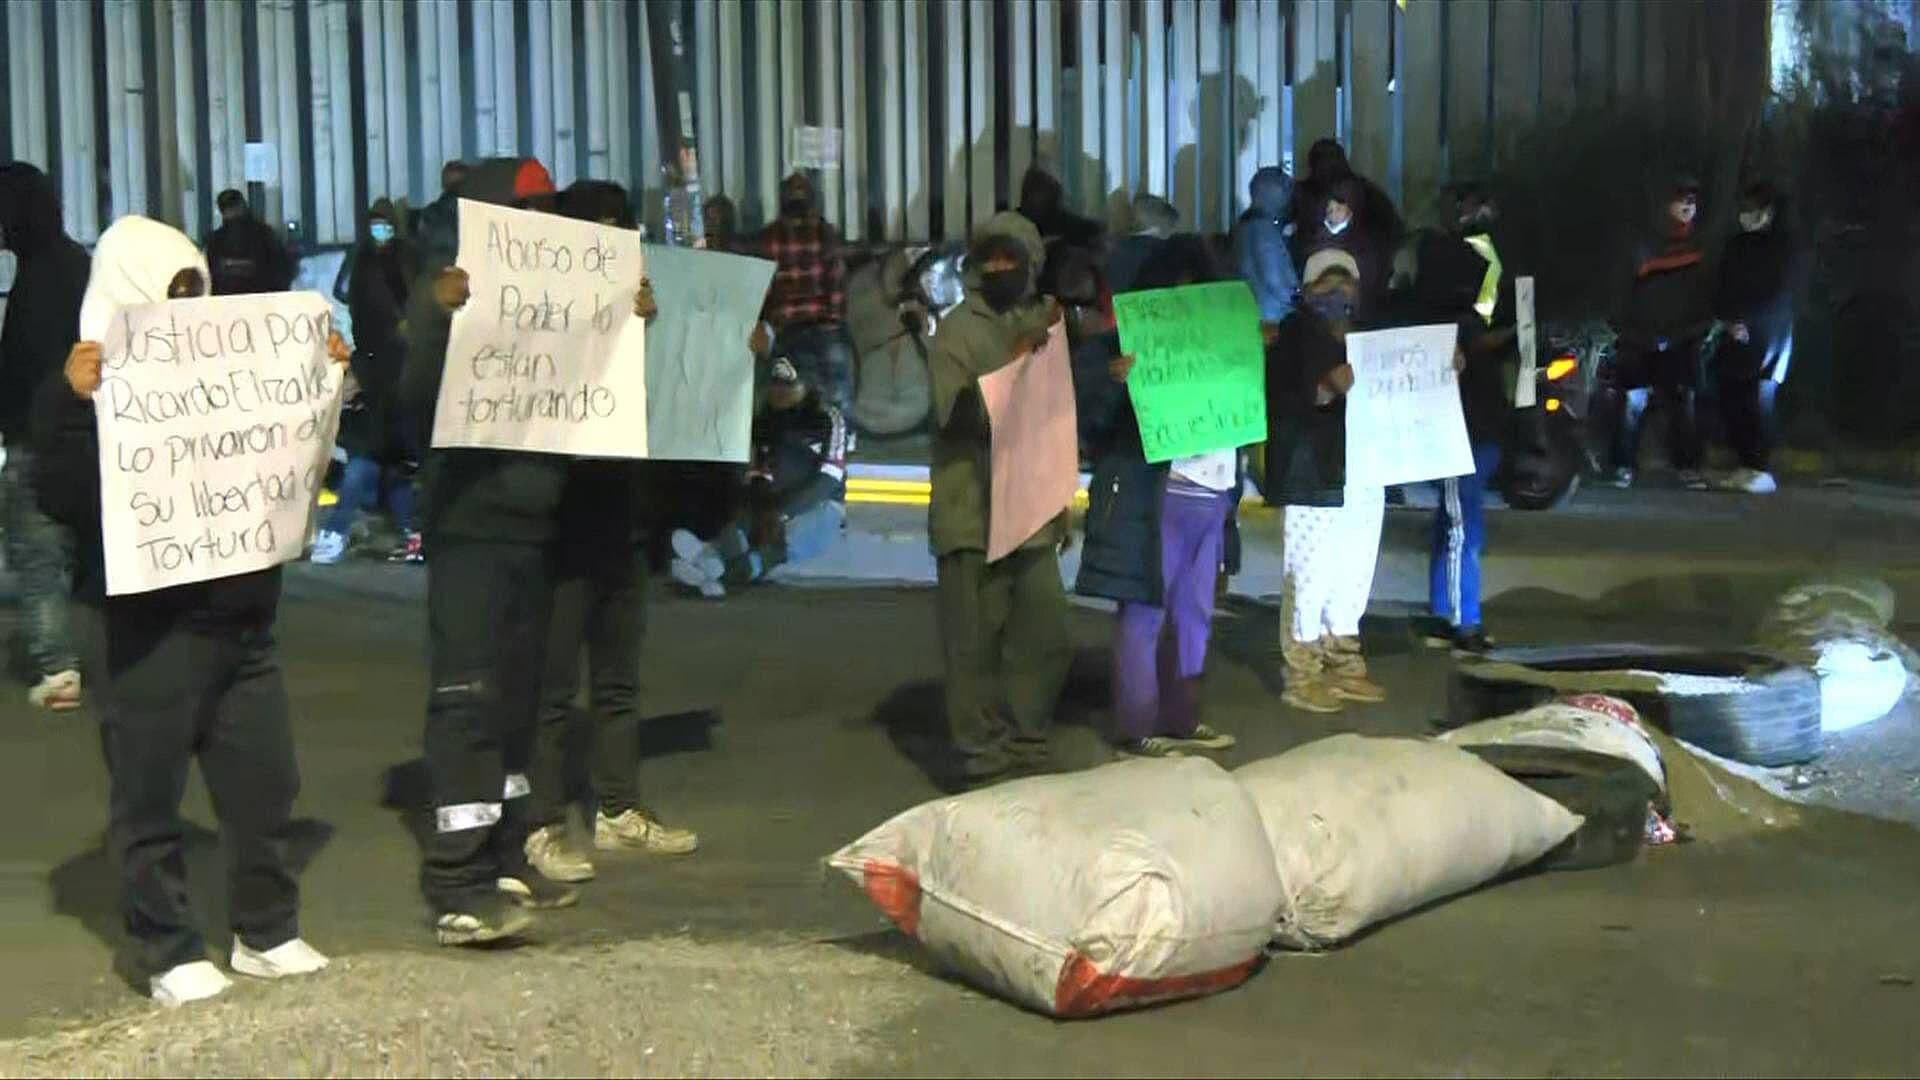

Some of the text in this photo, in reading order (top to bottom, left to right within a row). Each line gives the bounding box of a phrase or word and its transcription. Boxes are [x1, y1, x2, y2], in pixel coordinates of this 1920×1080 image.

[486, 221, 617, 279] Abuso de
[105, 310, 257, 370] Justicia
[103, 376, 230, 425] Ricardo
[136, 518, 276, 572] Tortura
